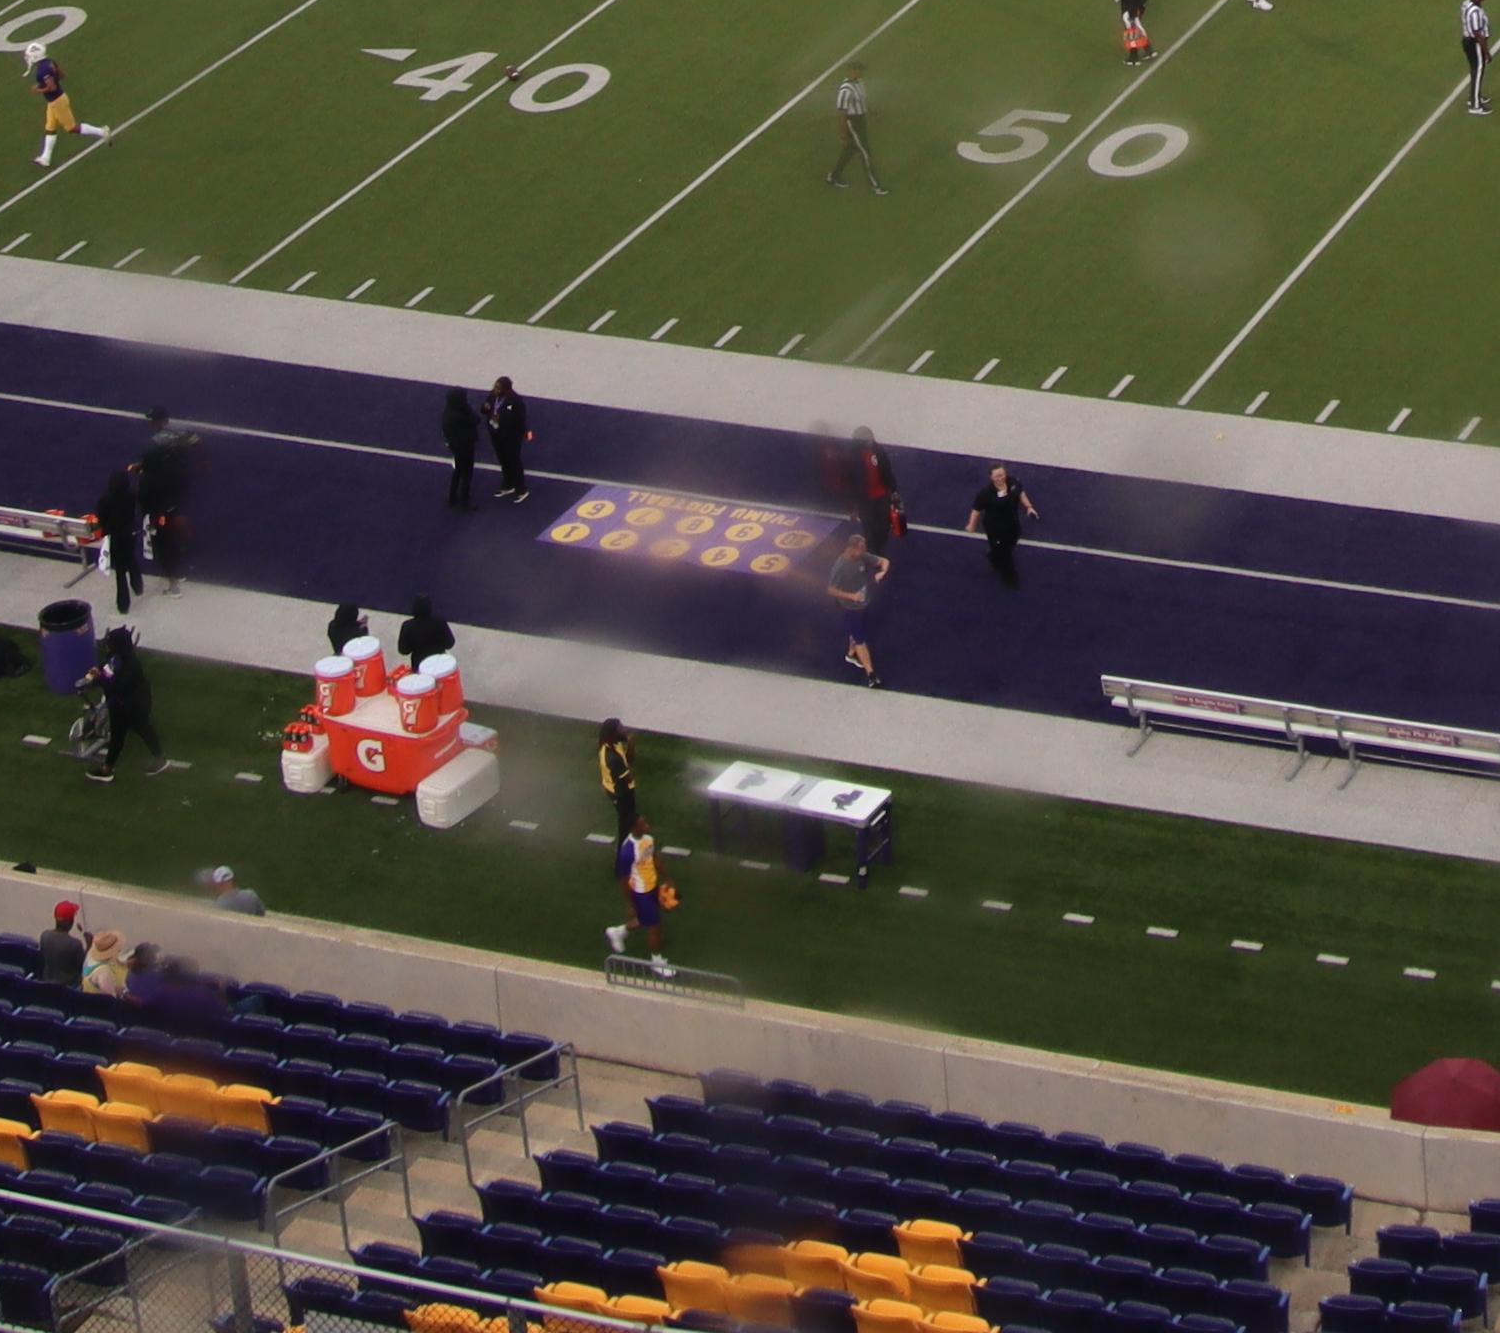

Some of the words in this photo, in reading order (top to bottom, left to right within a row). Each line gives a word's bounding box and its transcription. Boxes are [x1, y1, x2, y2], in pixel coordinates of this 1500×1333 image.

[392, 52, 612, 114] 40
[955, 108, 1190, 177] 50
[587, 503, 605, 516] 6
[626, 490, 727, 517] FOOTBALL
[689, 518, 704, 532] 8
[728, 508, 801, 527] PVAMU
[565, 526, 580, 540] 1
[739, 526, 754, 539] 9
[611, 534, 629, 547] 2
[712, 549, 728, 564] 4
[761, 556, 780, 571] 5
[356, 739, 386, 773] G
